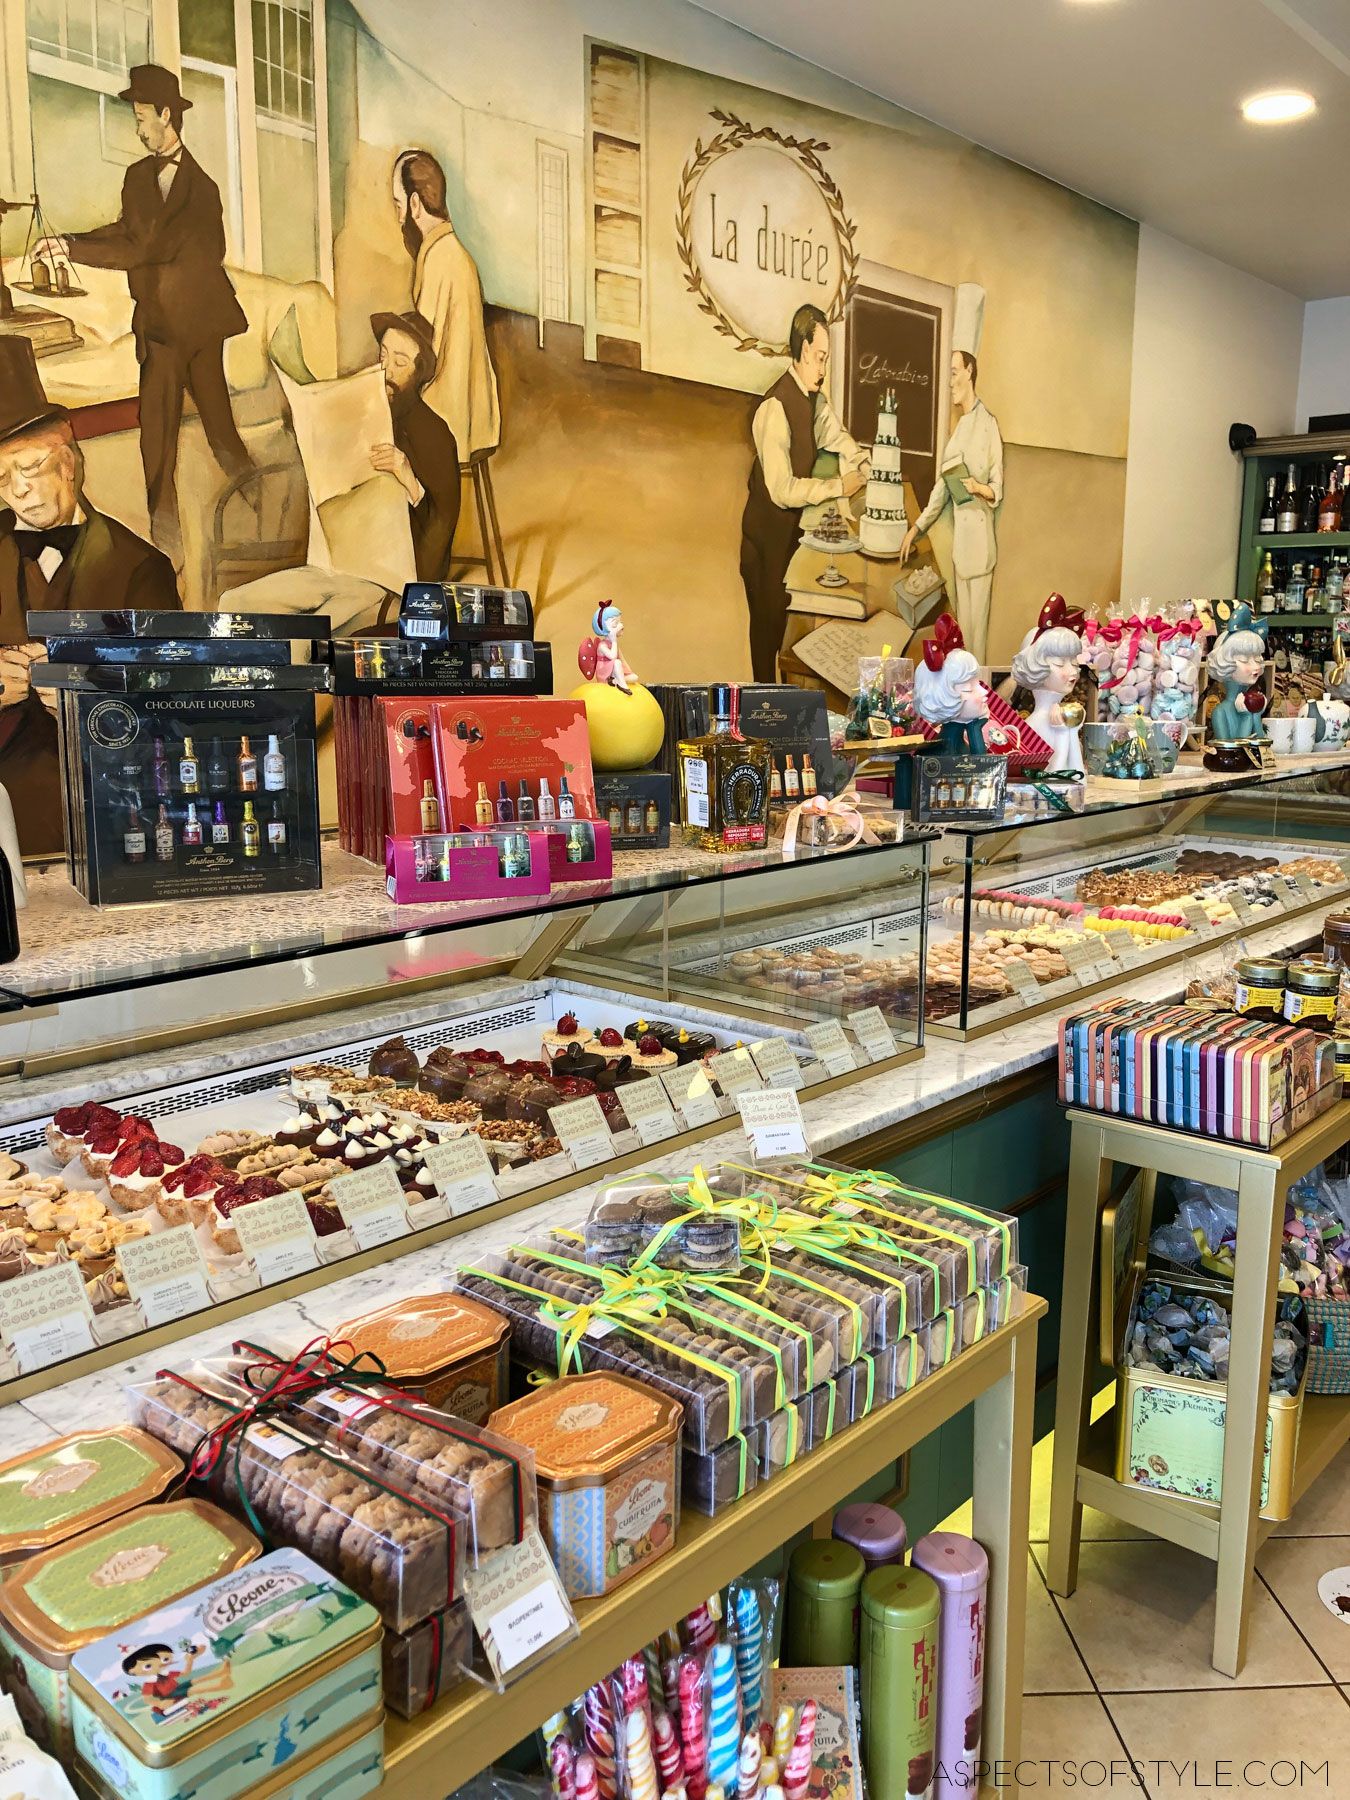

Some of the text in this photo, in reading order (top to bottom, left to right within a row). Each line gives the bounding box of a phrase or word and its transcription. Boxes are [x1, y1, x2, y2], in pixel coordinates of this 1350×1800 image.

[711, 193, 828, 285] La durée
[145, 699, 255, 710] CHOCOLATE LIQUEURS
[729, 768, 761, 786] HERRADURA
[629, 1482, 654, 1510] Leone
[217, 1578, 285, 1622] Leone
